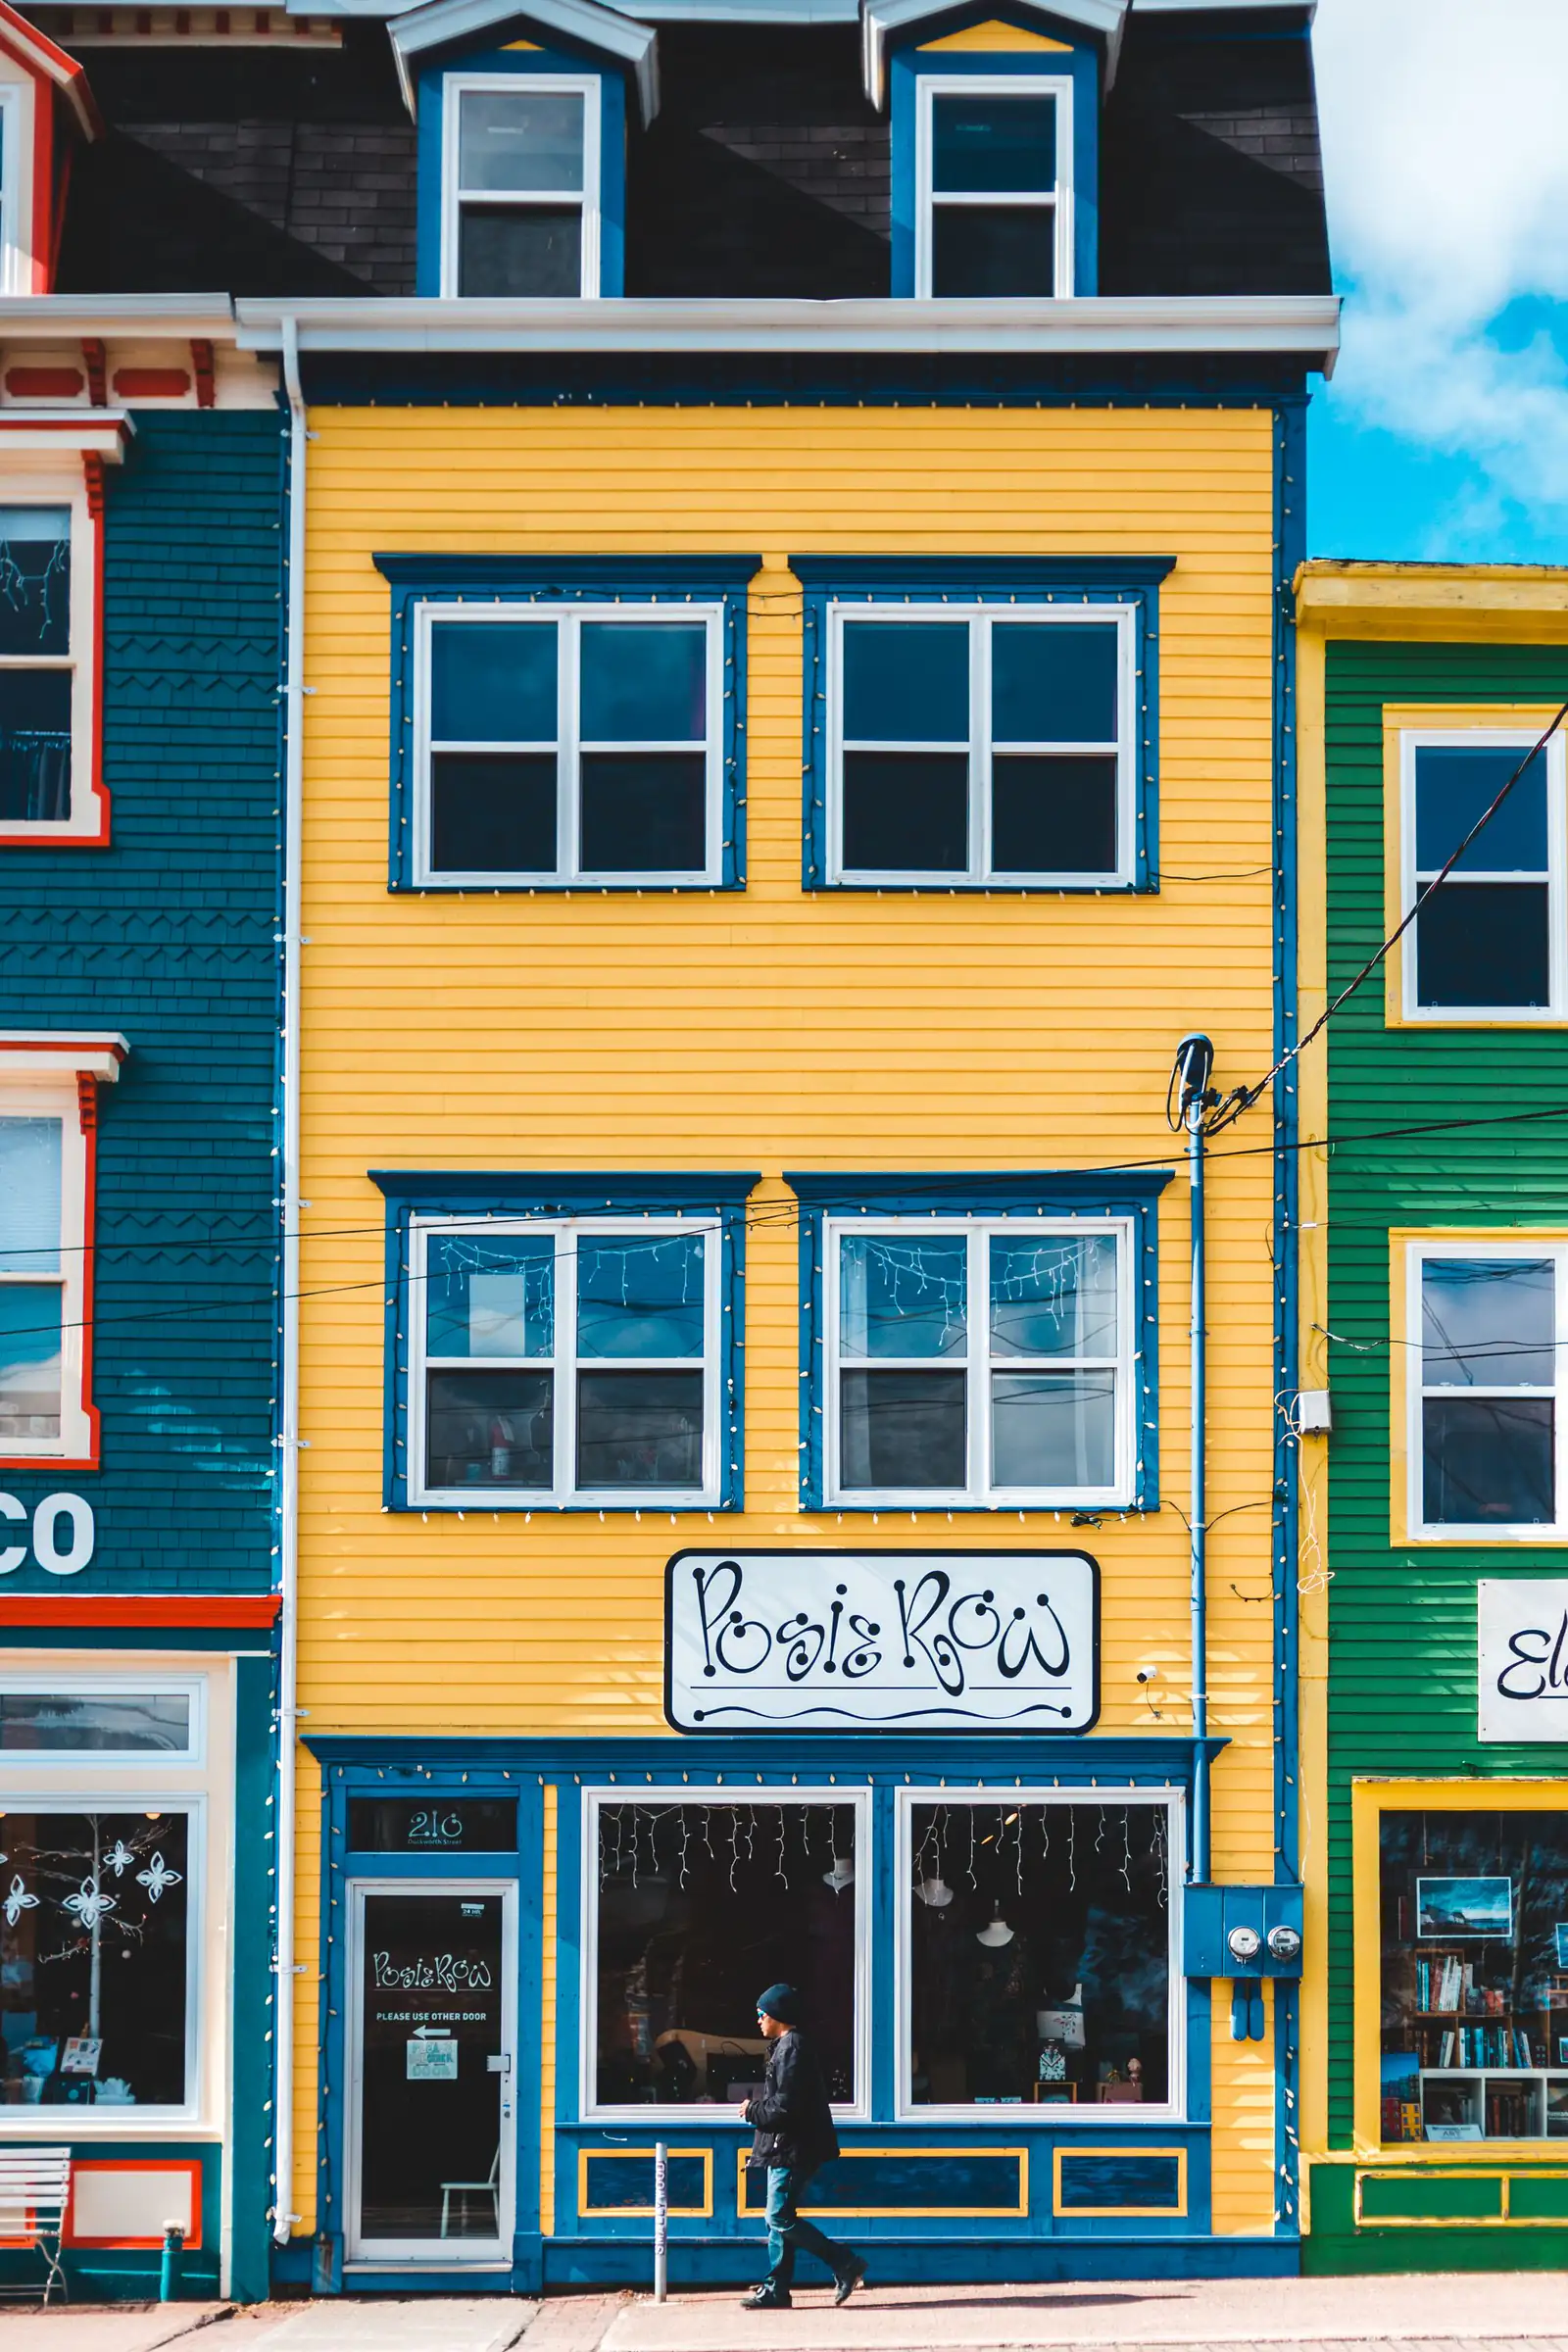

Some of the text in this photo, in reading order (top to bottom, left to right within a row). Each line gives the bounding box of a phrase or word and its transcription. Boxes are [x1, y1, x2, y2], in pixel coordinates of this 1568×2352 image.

[693, 1560, 1070, 1697] Posie Row
[1497, 1608, 1568, 1700] El
[373, 1951, 491, 1992] Posie Row
[376, 2012, 487, 2021] PLEASE USE OTHER DOOR
